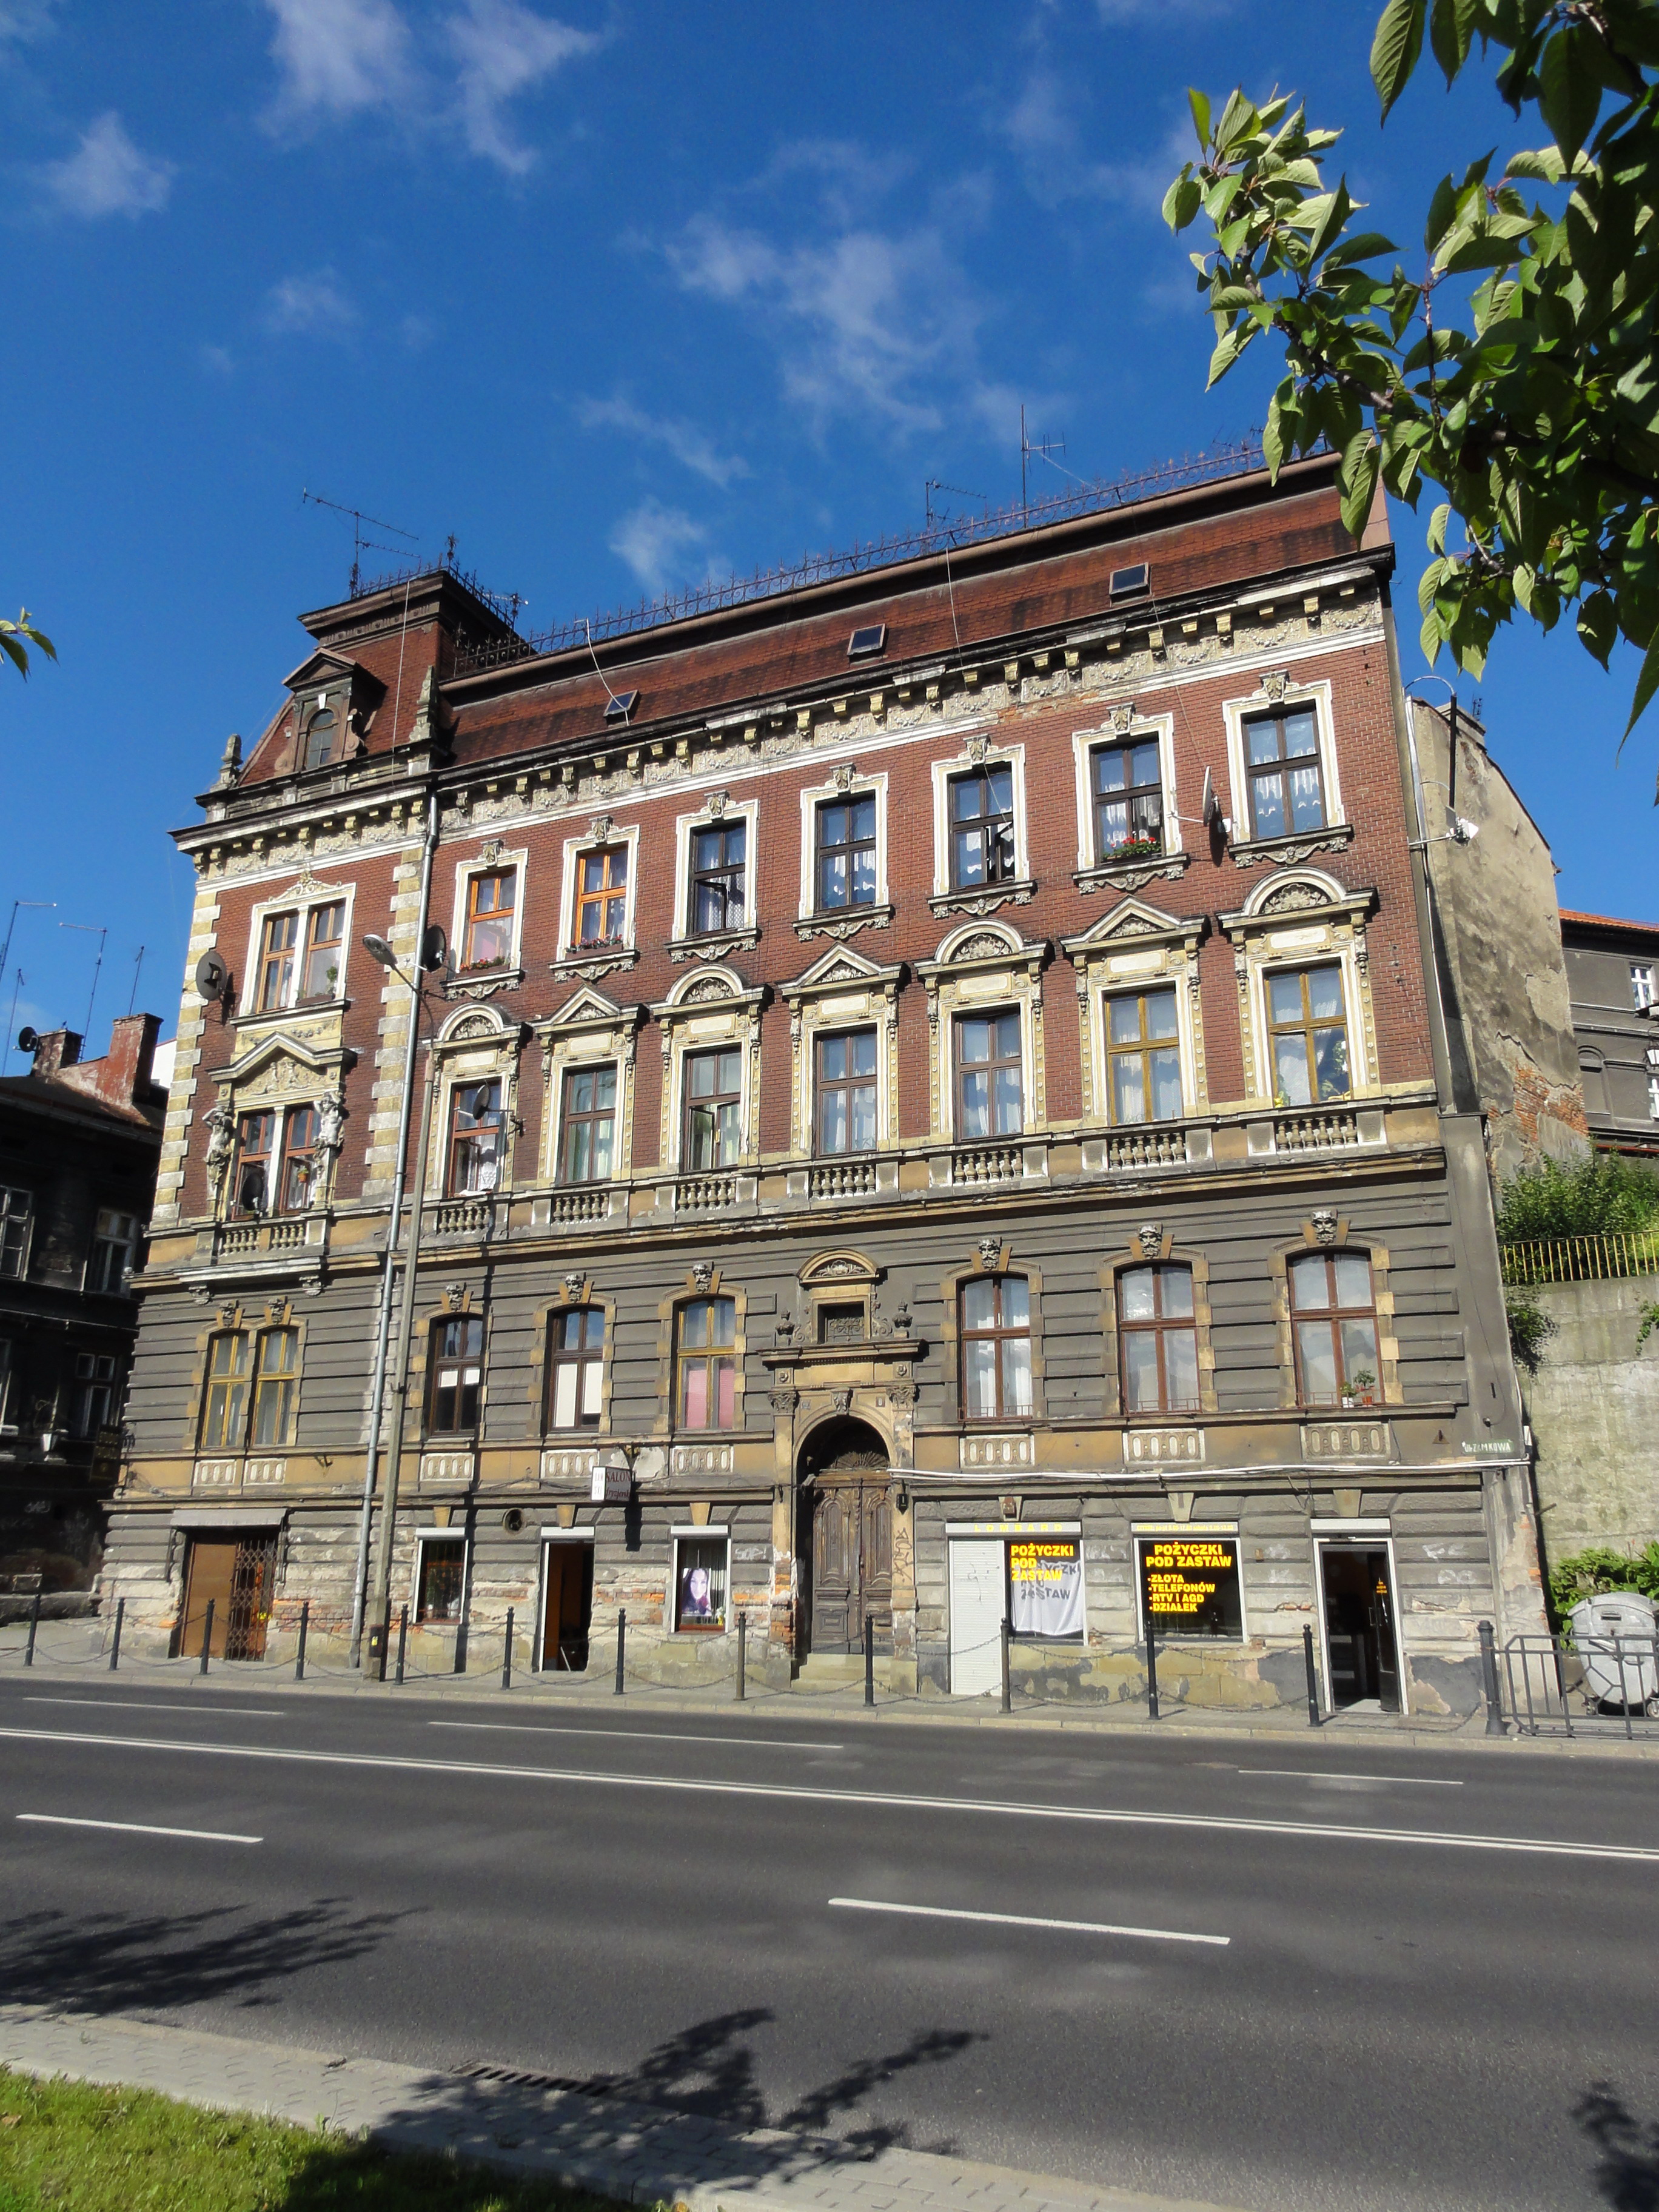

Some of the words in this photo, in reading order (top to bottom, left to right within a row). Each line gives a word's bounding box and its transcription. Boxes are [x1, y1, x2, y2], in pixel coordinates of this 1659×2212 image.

[606, 1471, 631, 1482] SALON
[1011, 1543, 1074, 1556] POŻYCZKI
[1155, 1541, 1222, 1555] POŻYCZKI
[1011, 1558, 1037, 1569] POD
[1146, 1557, 1174, 1567] POD
[1177, 1556, 1232, 1567] ZASTAW
[1011, 1570, 1062, 1581] ZASTAW
[1176, 1593, 1179, 1602] I
[1181, 1594, 1204, 1603] AGD
